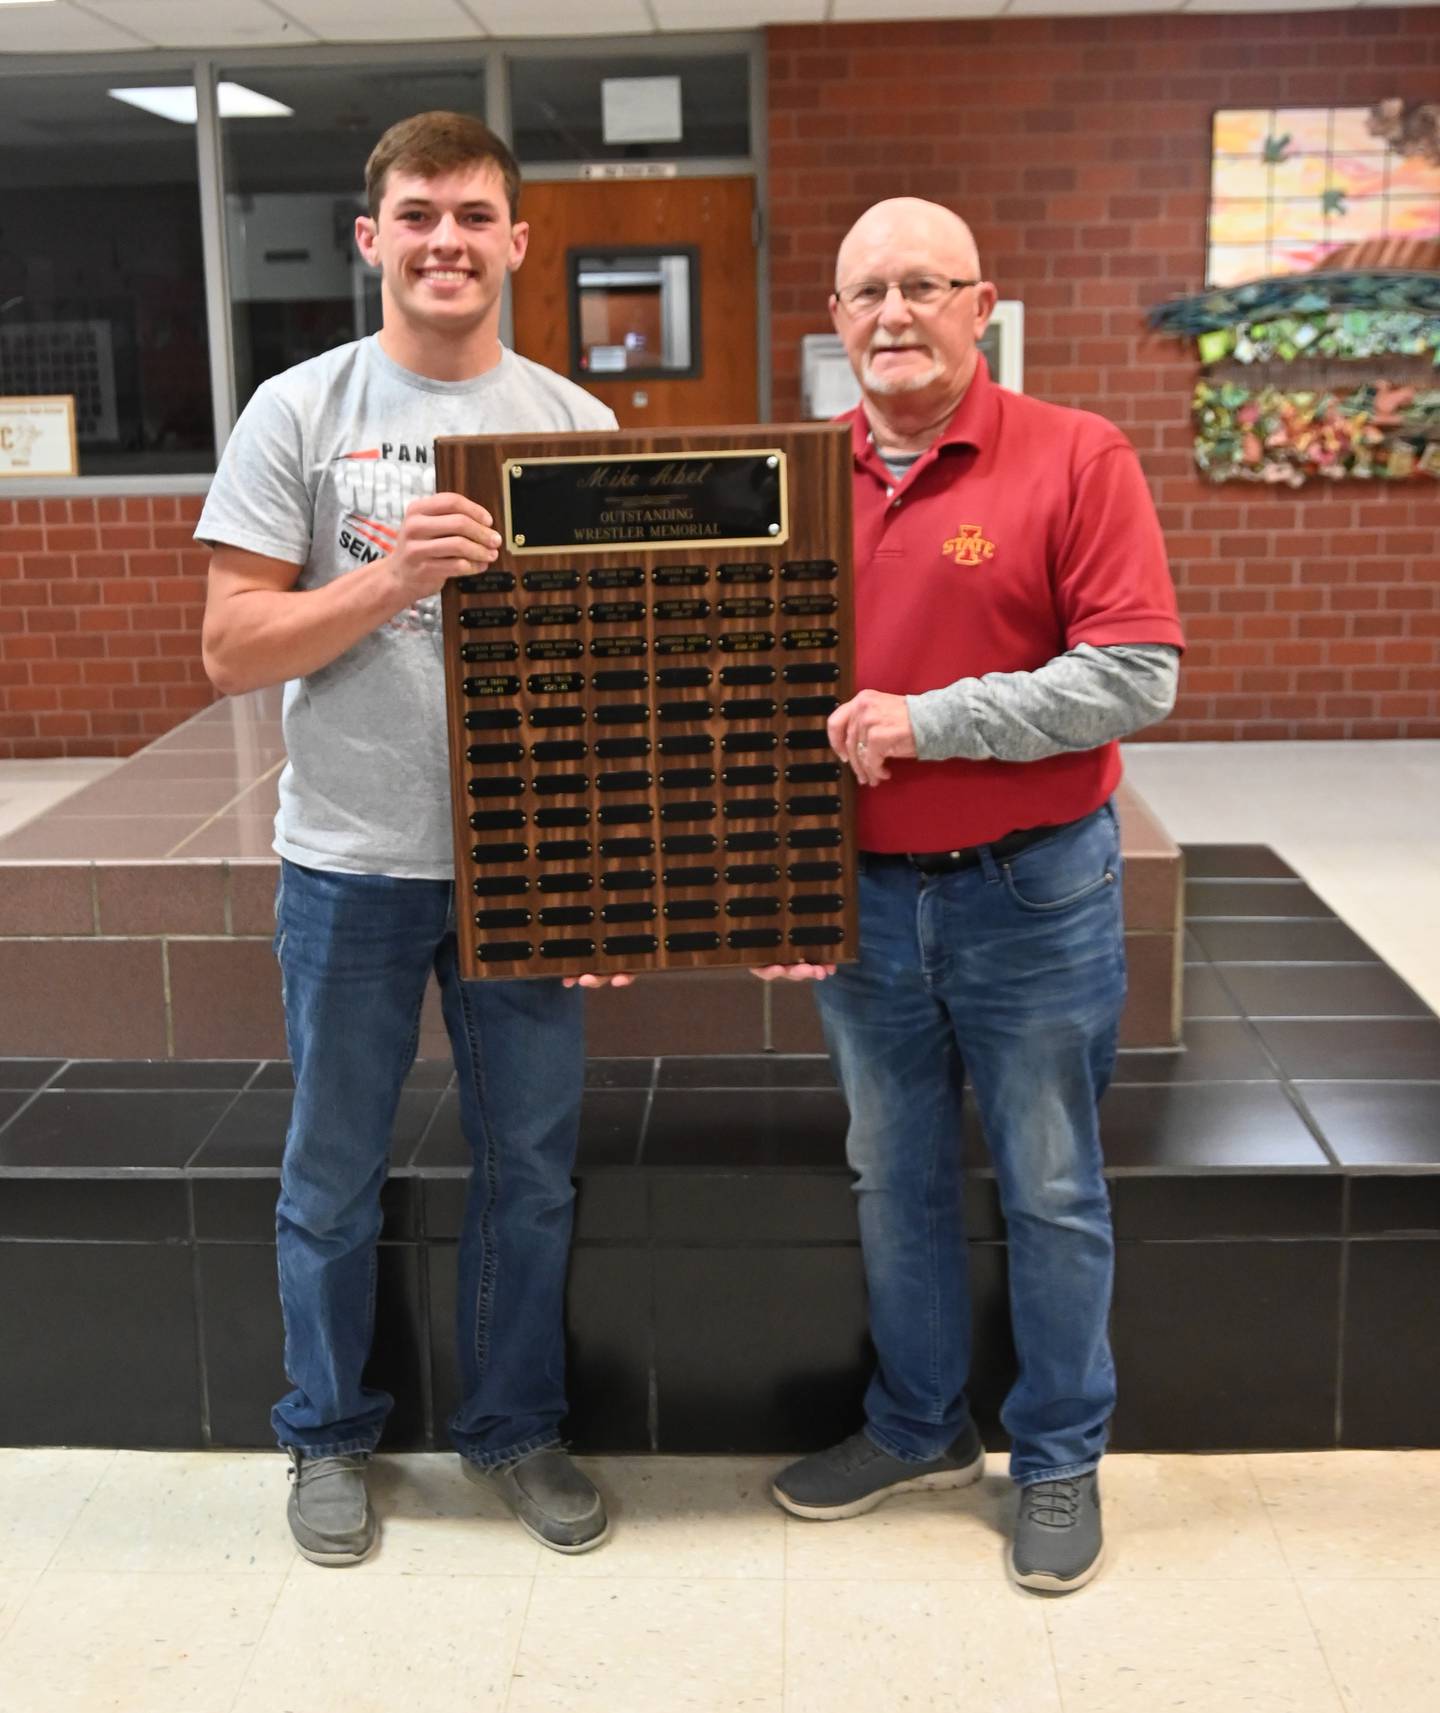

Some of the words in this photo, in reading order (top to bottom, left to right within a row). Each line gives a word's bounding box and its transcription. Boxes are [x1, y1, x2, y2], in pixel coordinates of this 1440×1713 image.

[382, 442, 429, 463] PAN
[576, 465, 640, 489] Mike
[649, 461, 713, 486] Abel
[600, 507, 694, 523] OUTSTANDING
[574, 526, 645, 541] WRESTLER
[649, 523, 721, 538] MEMORIAL
[338, 530, 386, 564] SEN
[942, 536, 996, 559] STATE
